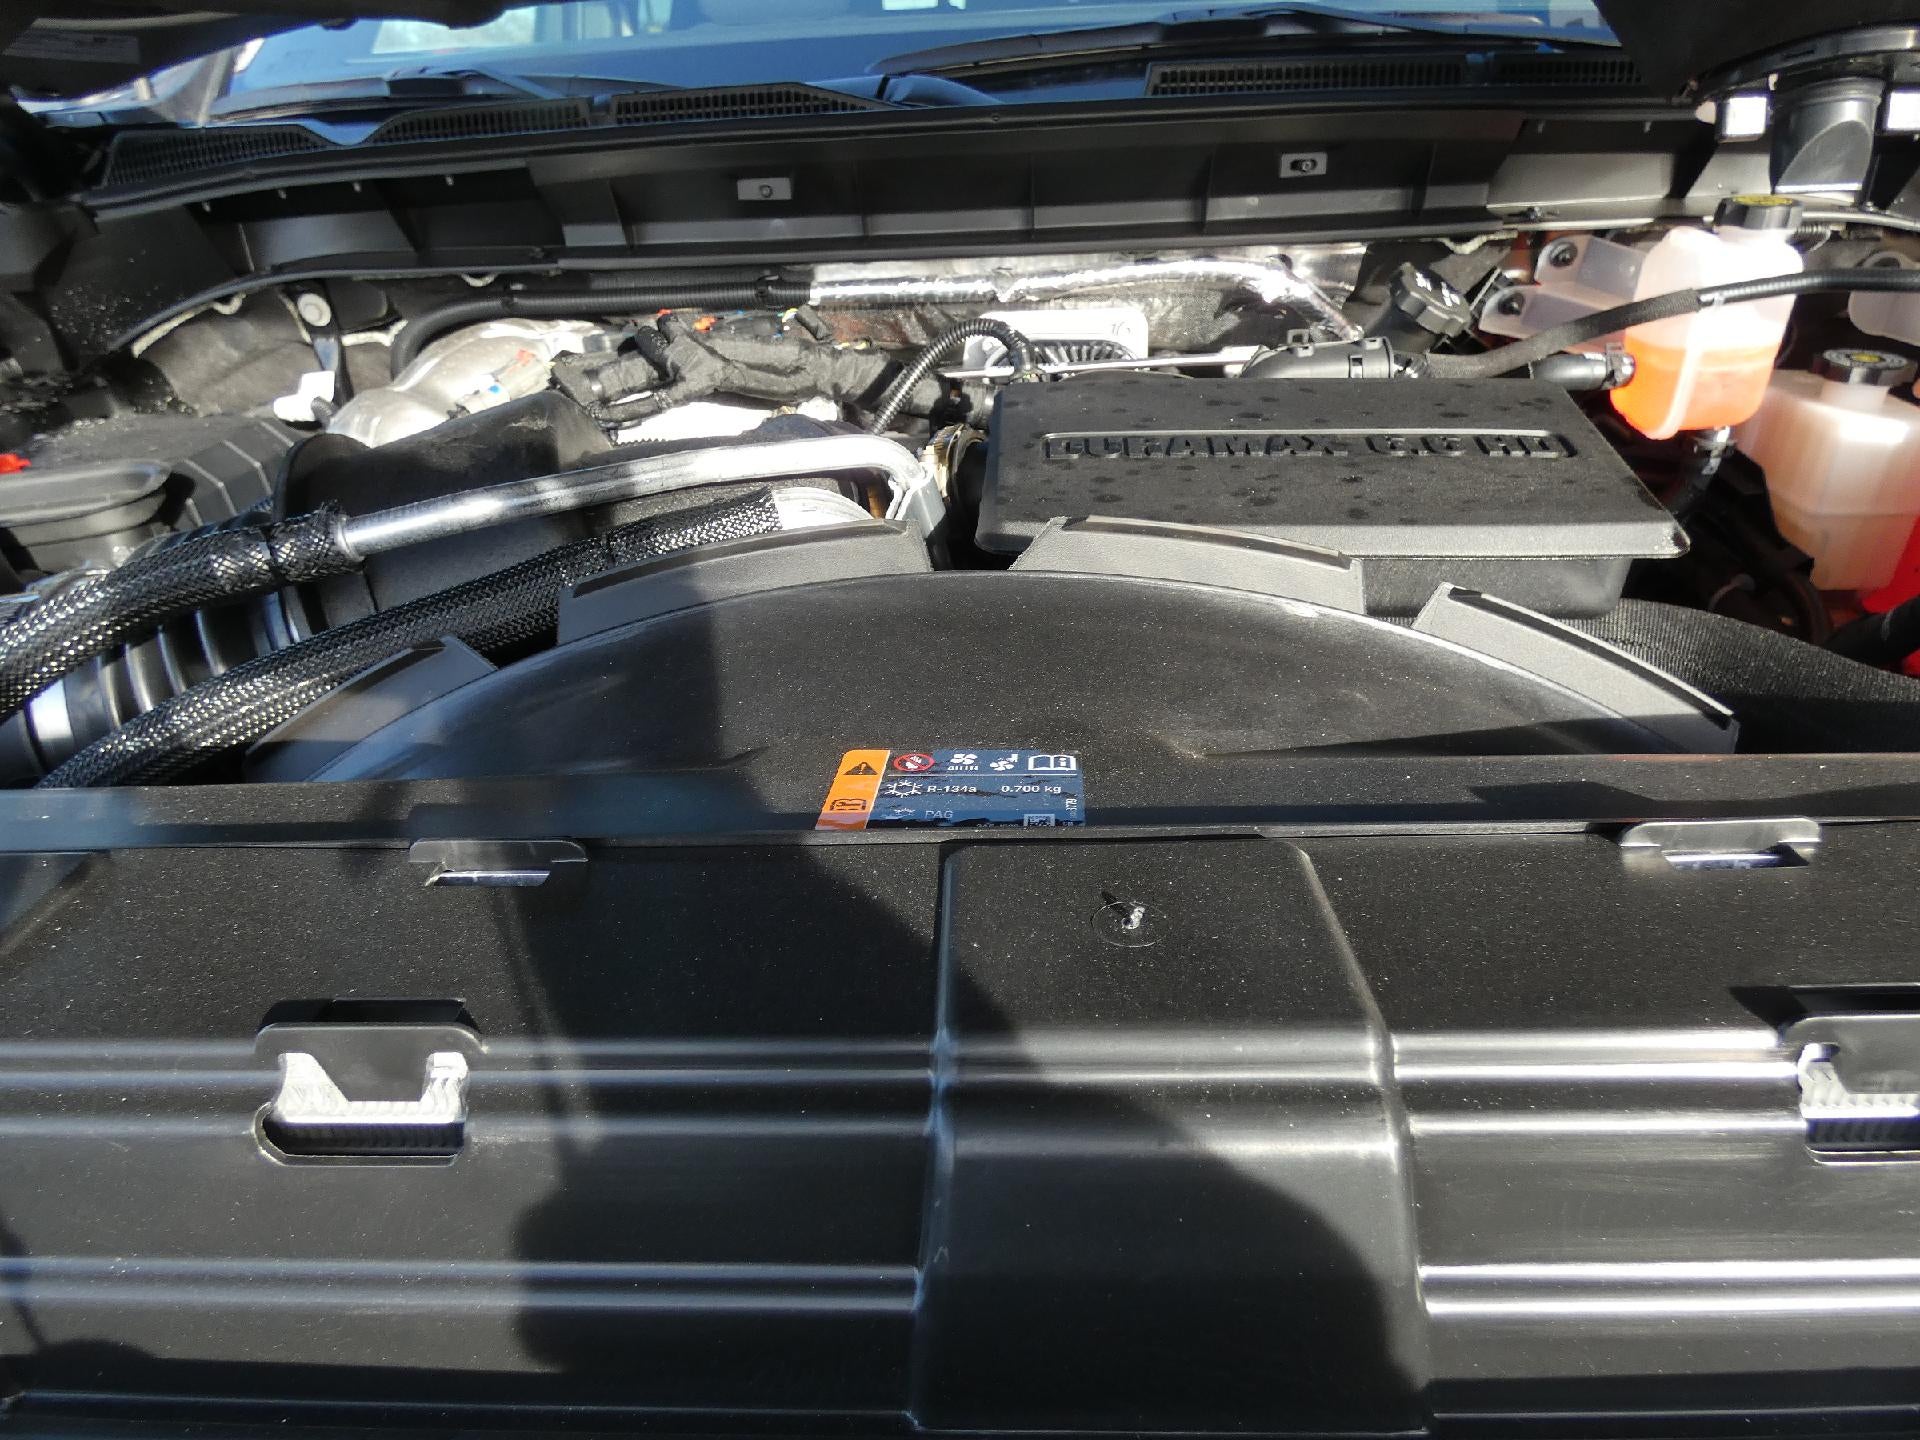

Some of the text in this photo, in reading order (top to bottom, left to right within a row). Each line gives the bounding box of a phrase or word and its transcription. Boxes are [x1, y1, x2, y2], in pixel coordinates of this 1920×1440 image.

[1045, 434, 1348, 459] DURAMAX
[926, 785, 1062, 793] R-134a 0.700 kg
[924, 810, 953, 820] PAG
